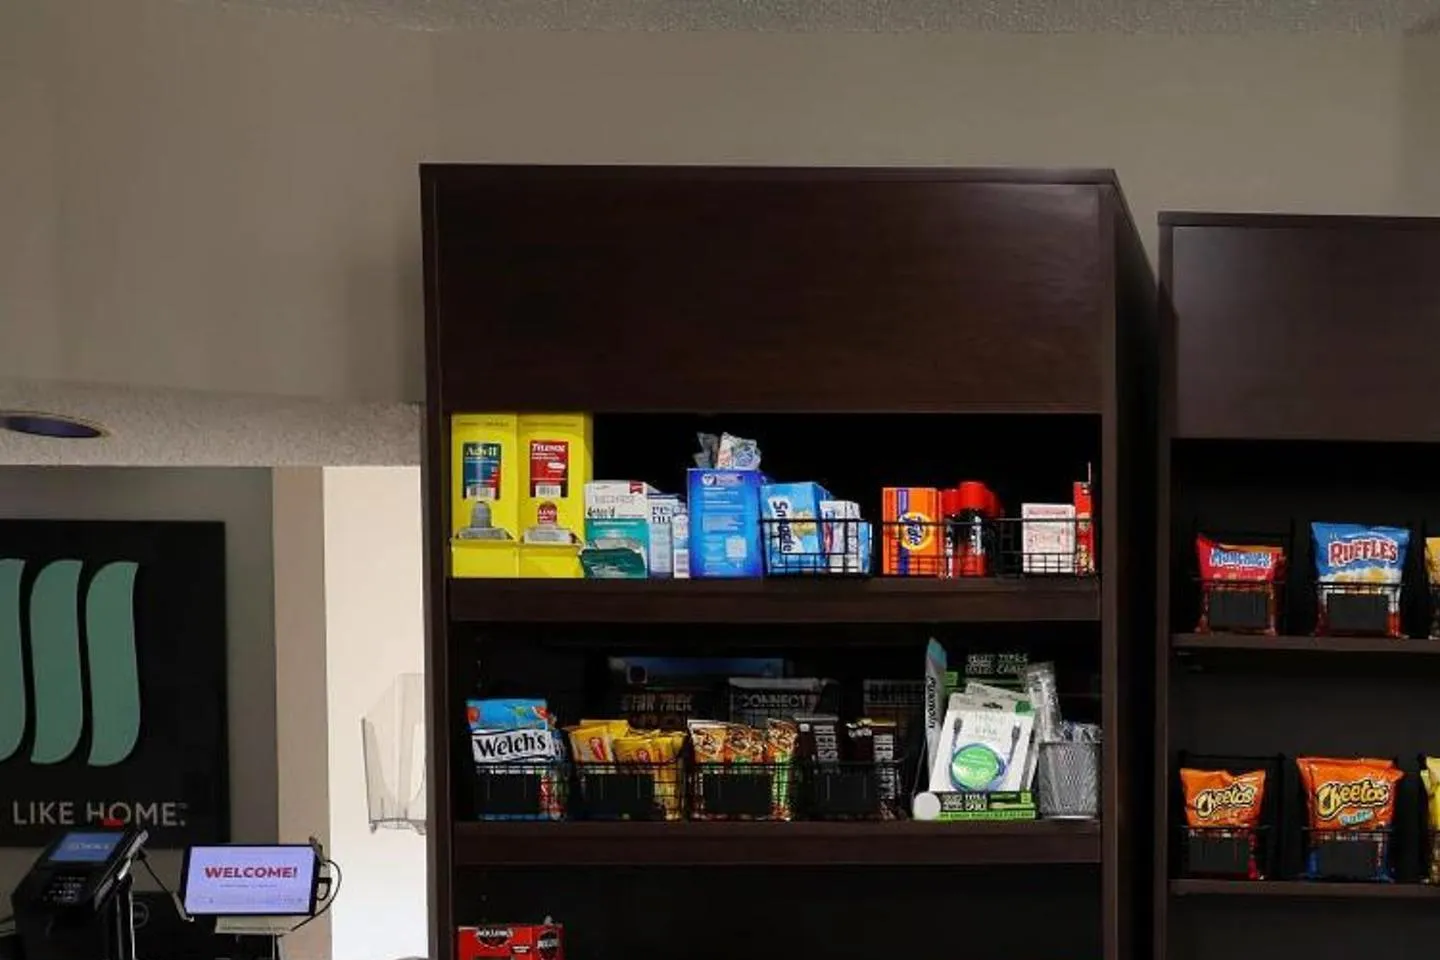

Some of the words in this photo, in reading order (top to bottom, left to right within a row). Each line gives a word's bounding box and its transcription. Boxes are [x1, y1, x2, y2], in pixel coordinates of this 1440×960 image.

[466, 446, 497, 457] Advil
[1328, 538, 1399, 568] RUFFLES
[474, 731, 547, 758] Welch's
[1196, 783, 1258, 819] Cheetos
[1316, 778, 1390, 820] Cheetos
[13, 802, 74, 825] LIKE
[205, 866, 298, 878] WELCOME!
